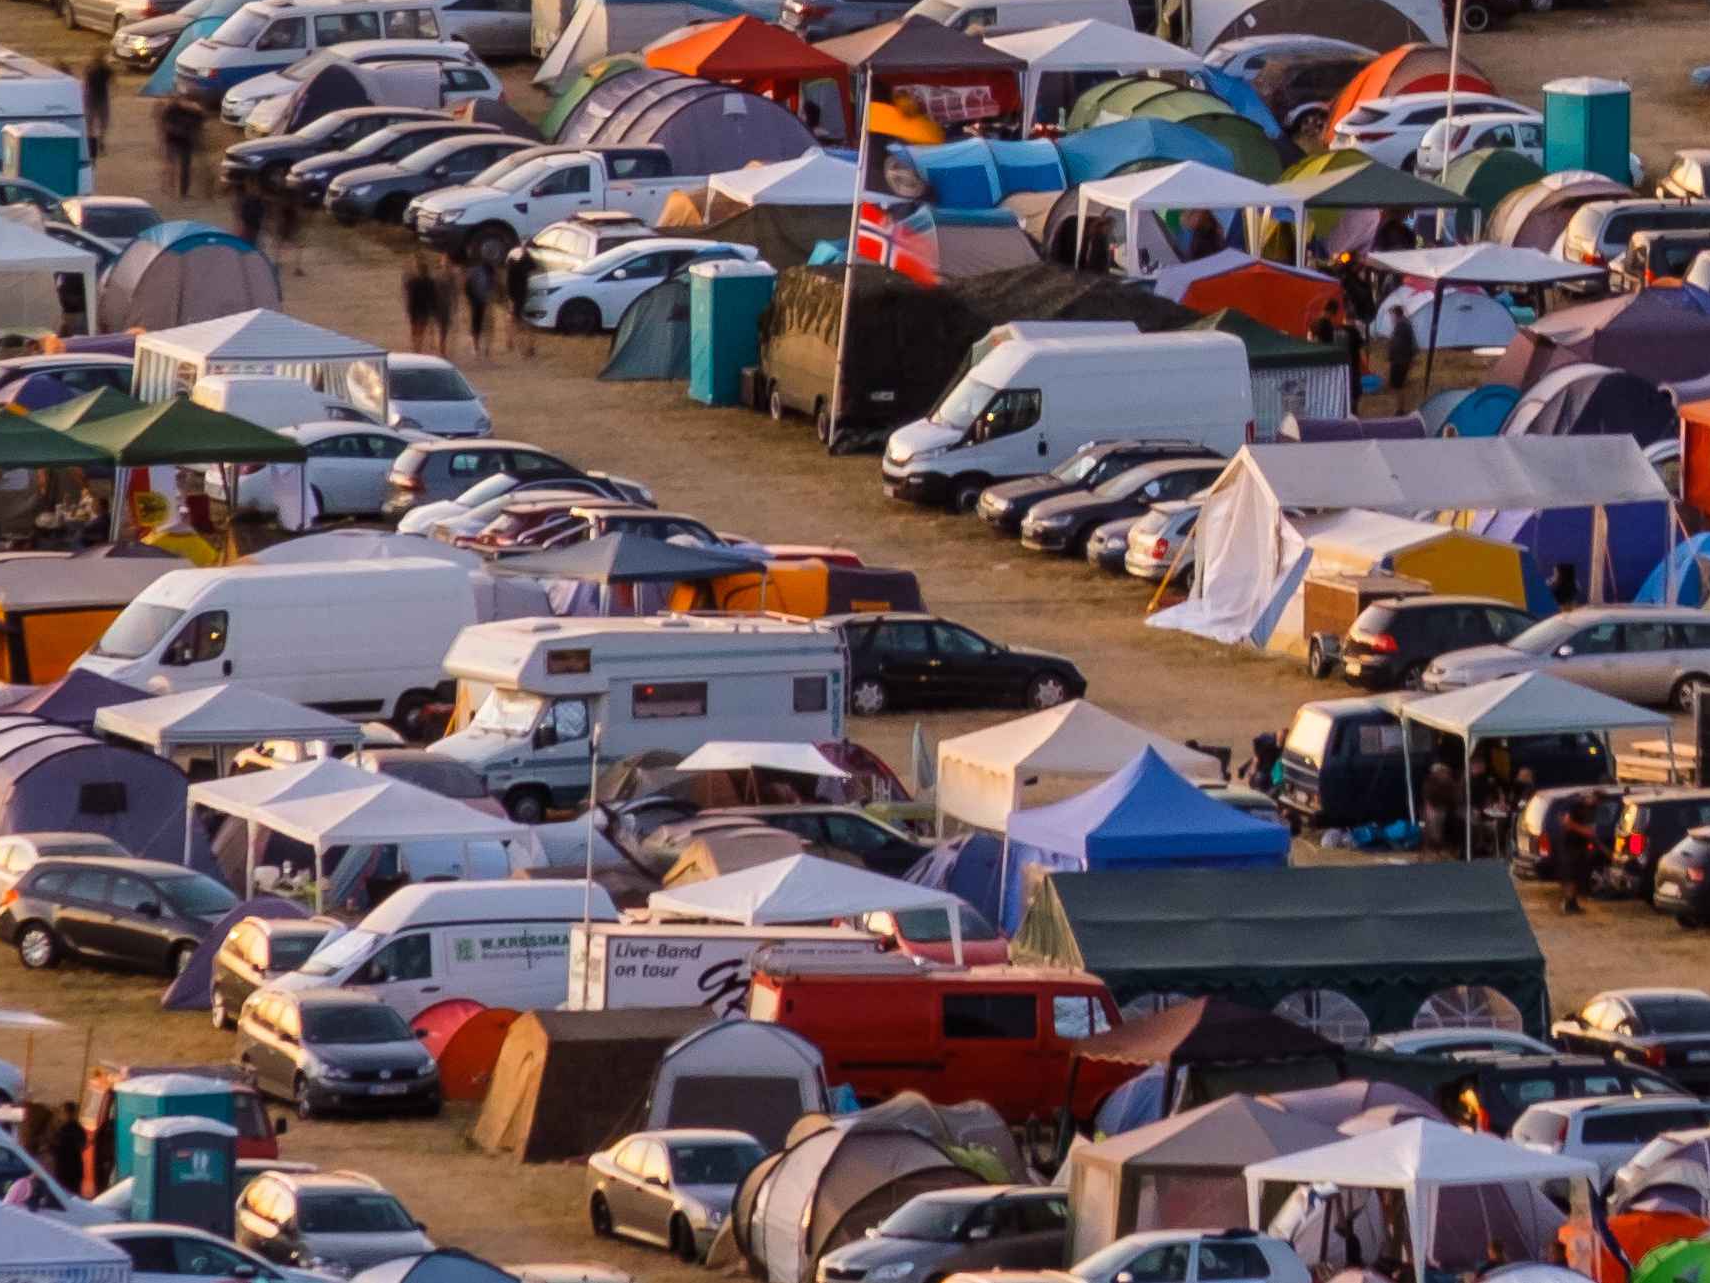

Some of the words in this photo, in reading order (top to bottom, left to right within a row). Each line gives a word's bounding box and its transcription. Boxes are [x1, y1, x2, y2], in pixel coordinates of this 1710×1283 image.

[614, 944, 702, 961] Live-Band
[614, 966, 636, 977] on
[642, 964, 679, 978] tour
